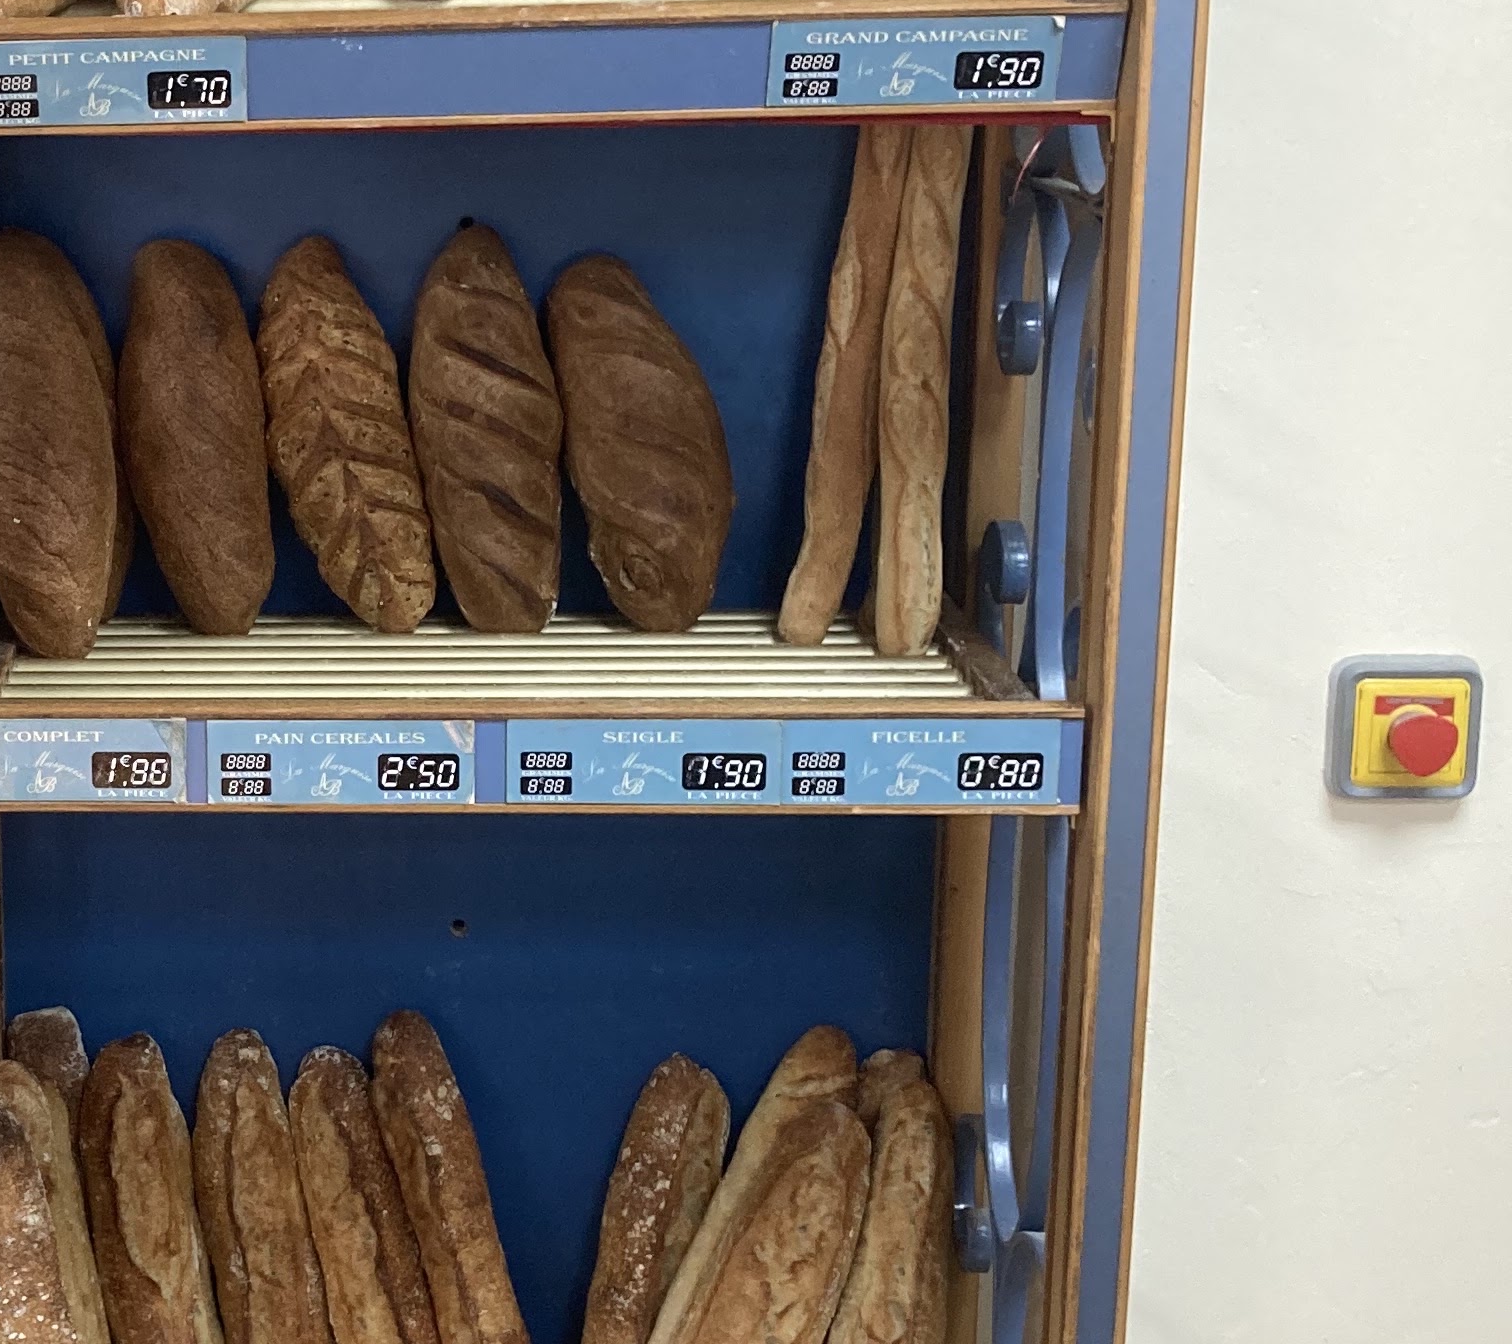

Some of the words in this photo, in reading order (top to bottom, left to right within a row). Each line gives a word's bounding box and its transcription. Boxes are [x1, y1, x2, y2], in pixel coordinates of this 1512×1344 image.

[807, 32, 888, 44] GRAND
[896, 29, 1029, 43] CAMPAGNE
[9, 53, 74, 66] PETIT
[80, 49, 207, 64] CAMPAGNE
[4, 731, 104, 742] COMPLET
[255, 733, 303, 744] PAIN
[311, 733, 425, 744] CEREALES
[602, 732, 683, 743] SEIGLE
[872, 732, 965, 743] FICELLE
